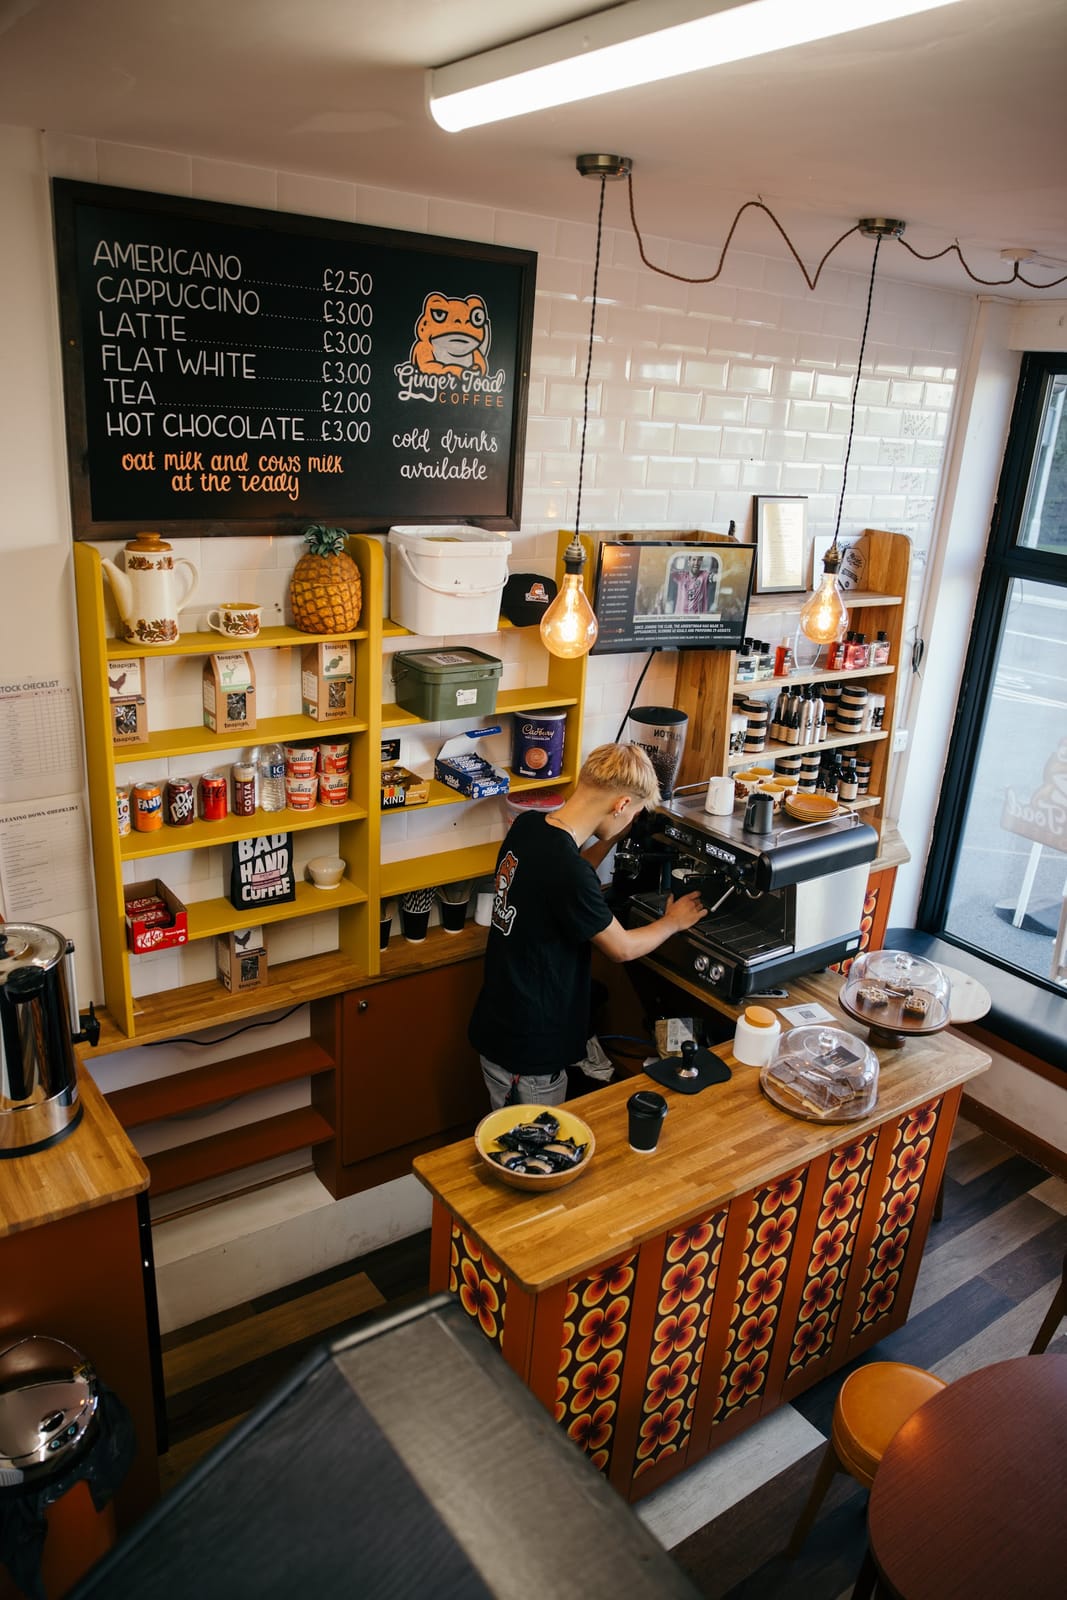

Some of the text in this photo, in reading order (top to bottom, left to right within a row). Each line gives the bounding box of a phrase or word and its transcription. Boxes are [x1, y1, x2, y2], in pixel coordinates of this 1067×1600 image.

[93, 240, 373, 296] AMERICANO £2.50
[97, 275, 373, 327] CAPPUCCINO £3.00
[99, 310, 372, 355] LATTE £3.00
[101, 344, 371, 385] FLAT WHITE £3.00
[104, 378, 371, 413] TEA £2.00
[397, 364, 503, 403] Ginger Toad
[439, 391, 504, 407] COFFEE
[106, 412, 371, 443] HOT CHOCOLATE £3.00
[392, 427, 498, 454] cold drinks
[122, 451, 344, 474] oat milk and cows milk
[400, 456, 488, 482] available
[171, 473, 300, 501] at the ready
[22, 680, 59, 691] CHECKLIST
[522, 723, 555, 738] Cadbury
[137, 795, 162, 810] FANT
[169, 797, 193, 824] Pepp
[244, 783, 252, 813] COSTA
[383, 795, 405, 806] KIND
[27, 811, 46, 820] DOWN
[46, 805, 79, 816] CHECKLIST
[238, 832, 287, 862] BAD
[240, 848, 289, 884] HAND
